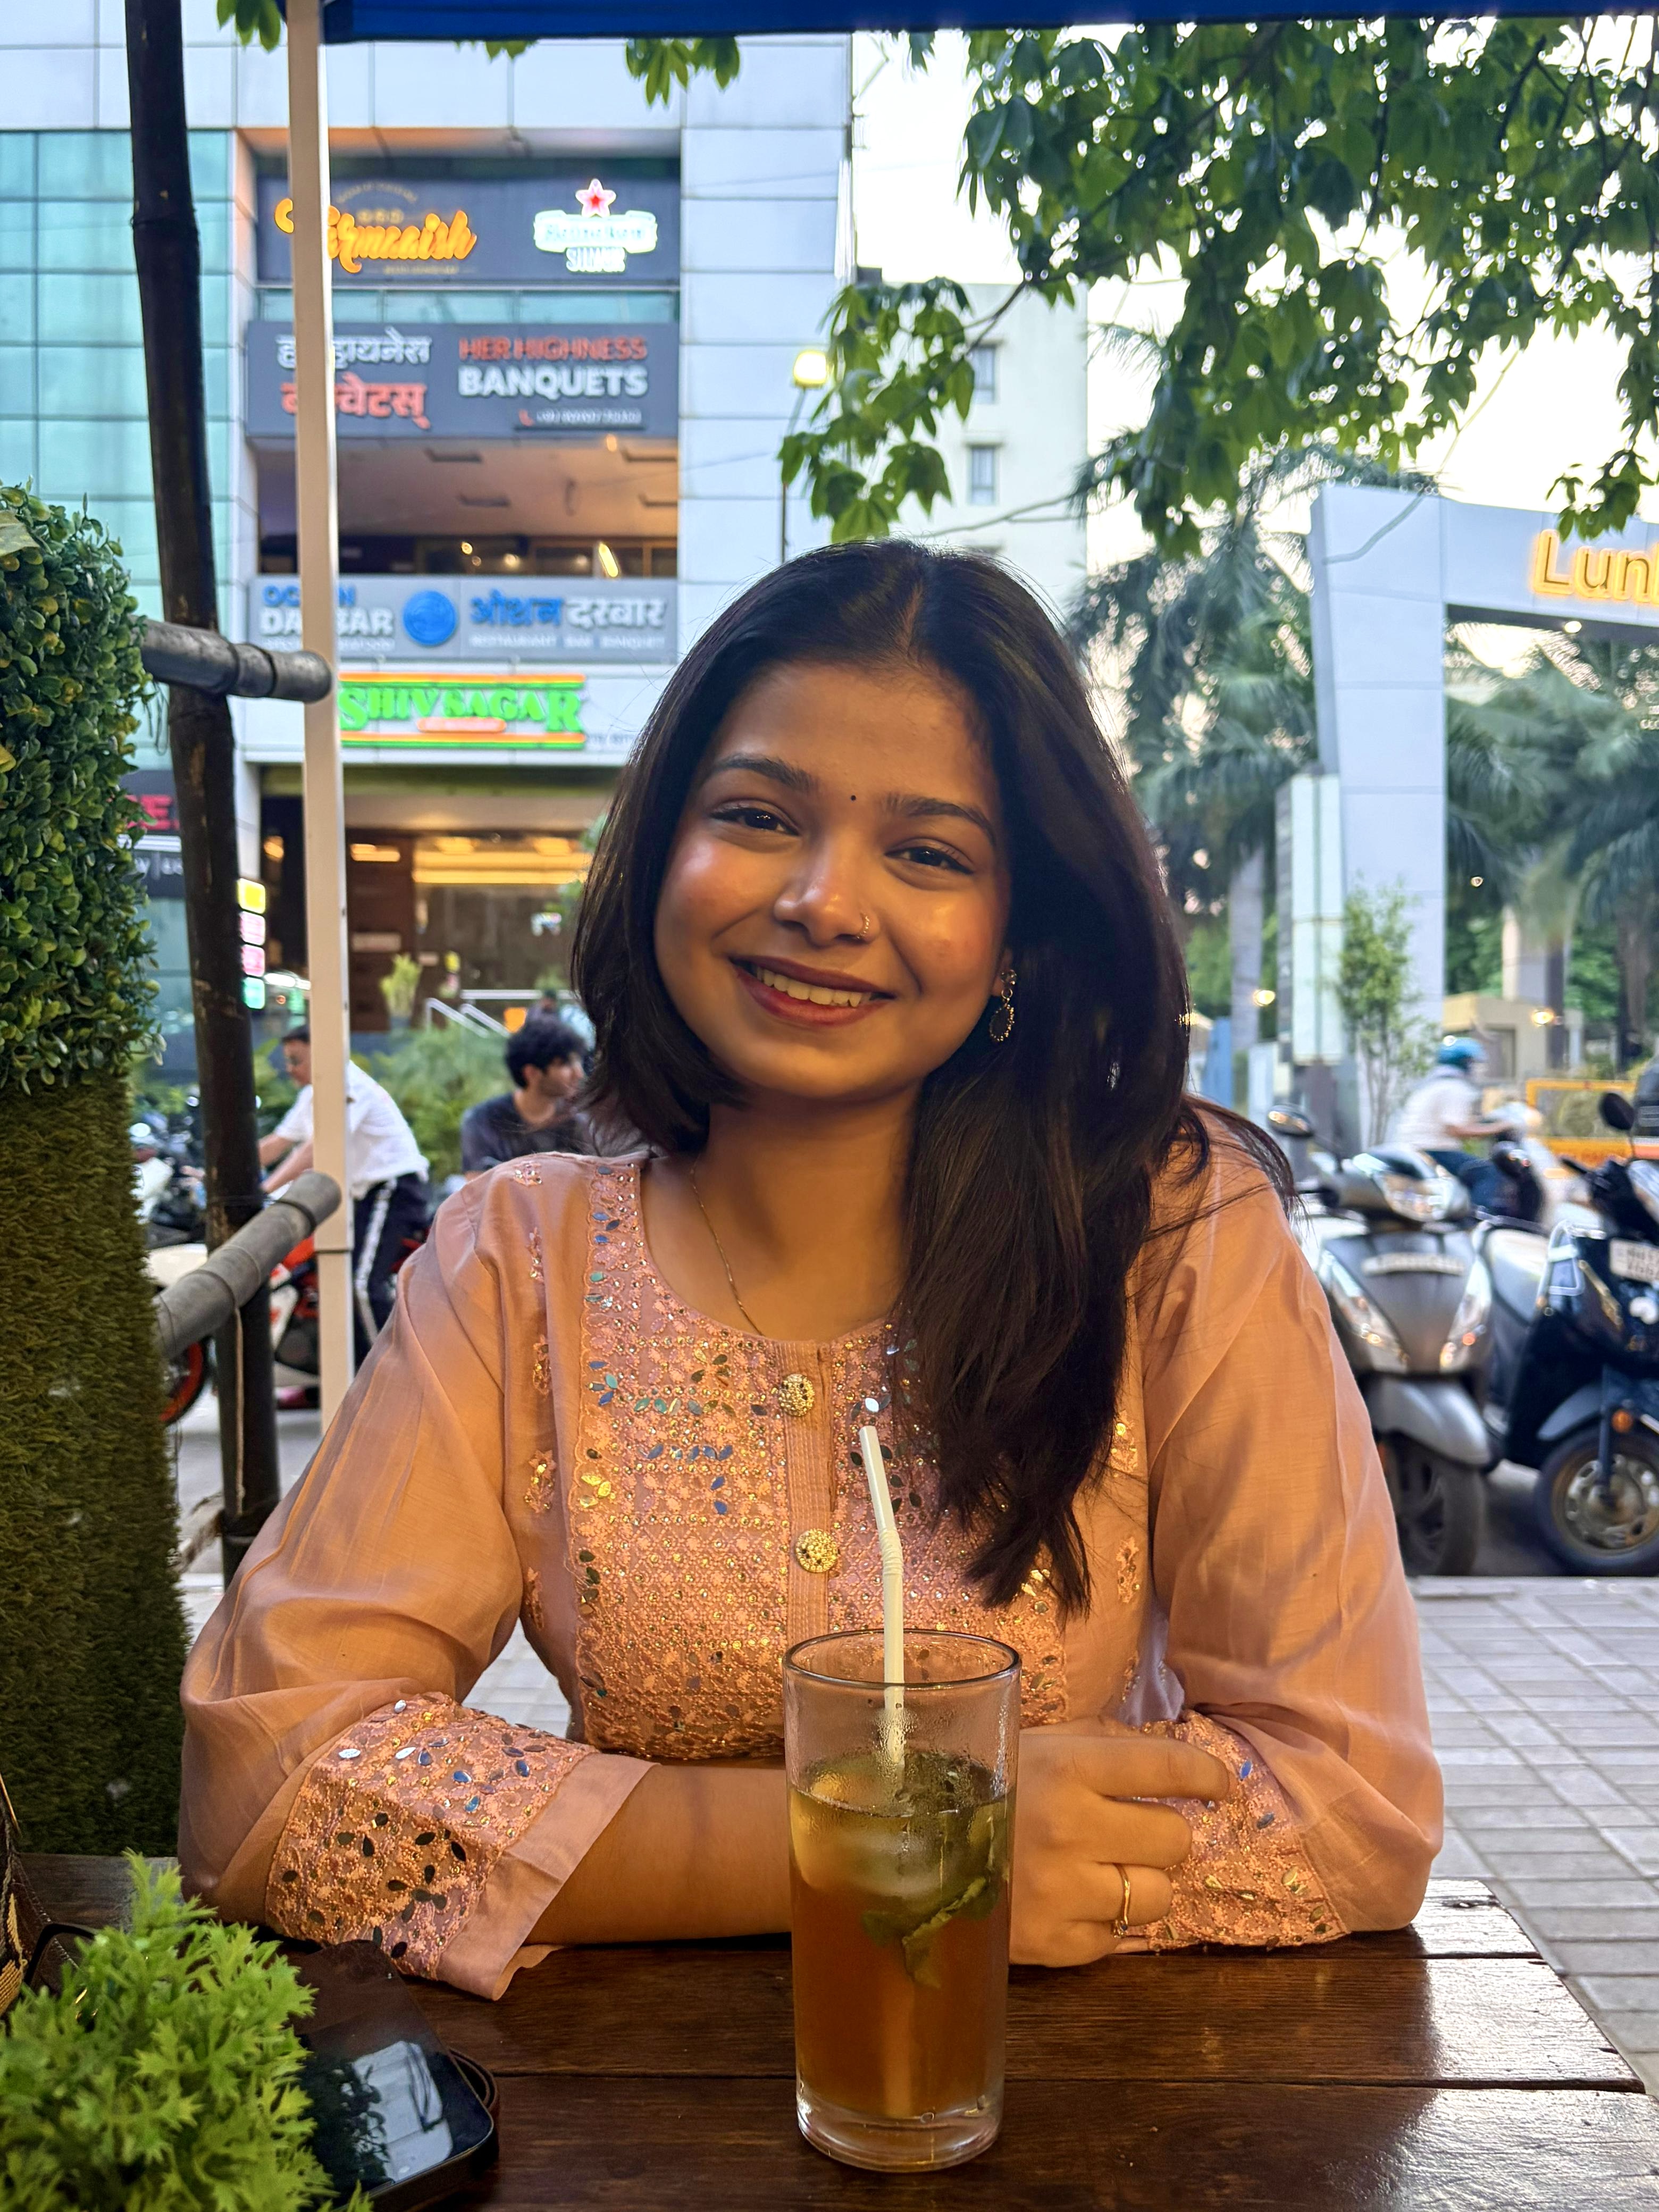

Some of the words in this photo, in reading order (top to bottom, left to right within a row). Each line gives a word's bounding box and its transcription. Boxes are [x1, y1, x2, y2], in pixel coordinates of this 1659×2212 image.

[459, 337, 511, 361] HER
[514, 336, 648, 361] HIGHNESS
[458, 365, 648, 400] BANQUETS
[1532, 528, 1659, 606] Lun
[262, 585, 356, 607] OCN
